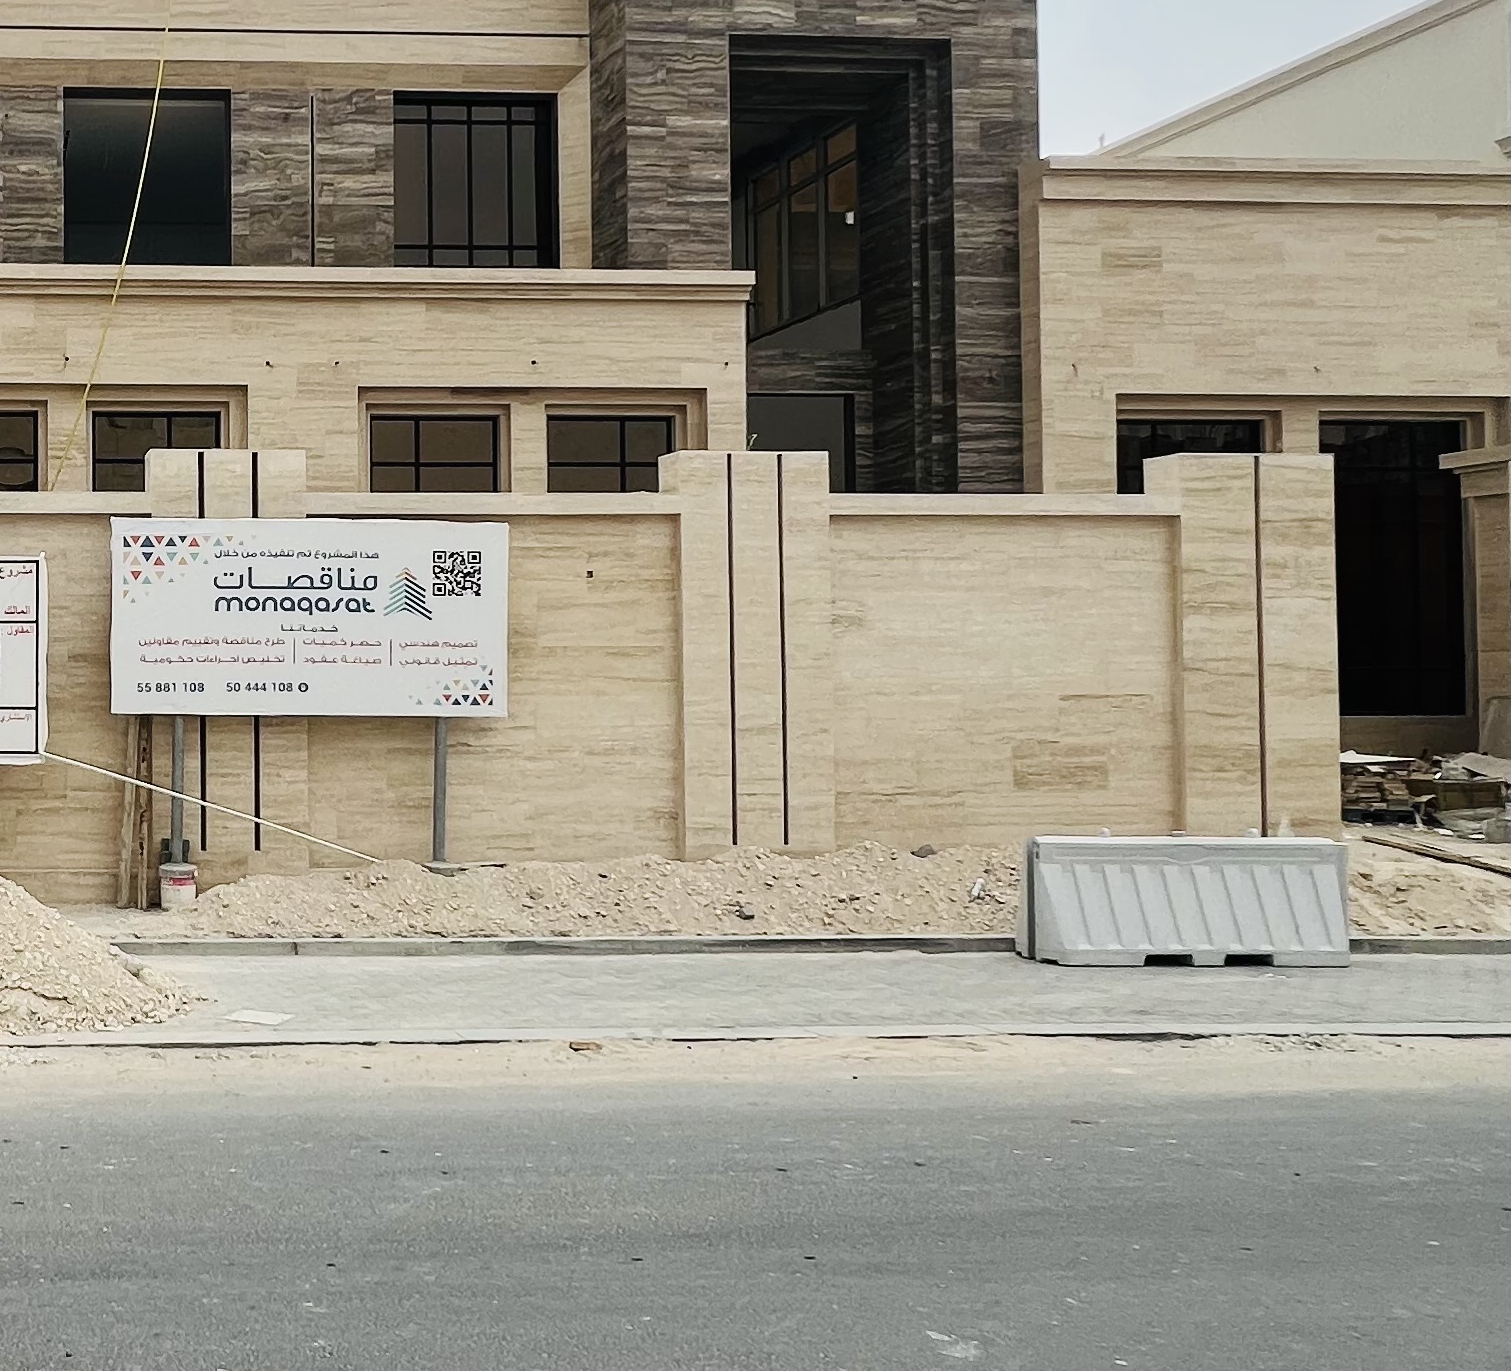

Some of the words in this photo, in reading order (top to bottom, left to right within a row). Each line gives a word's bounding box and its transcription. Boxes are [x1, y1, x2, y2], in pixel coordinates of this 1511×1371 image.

[214, 549, 239, 559] خلال
[241, 549, 257, 559] من
[260, 549, 295, 559] تنفيذه
[296, 549, 312, 559] تم
[314, 549, 357, 559] المشروع
[213, 567, 378, 591] مناقصات
[214, 596, 376, 616] monaqasat
[280, 623, 339, 633] خدماتنا
[138, 637, 180, 647] مقاولين
[222, 636, 262, 646] مناقصة
[264, 637, 286, 647] طرح
[302, 637, 346, 647] كميات
[398, 639, 440, 651] هندسي
[441, 639, 478, 649] تصميم
[140, 654, 194, 665] حكومية
[398, 656, 440, 668] قانوني
[137, 682, 152, 693] 55
[156, 682, 176, 693] 881
[183, 682, 205, 693] 108
[226, 682, 240, 693] 50
[245, 682, 266, 693] 444
[272, 682, 293, 693] 108
